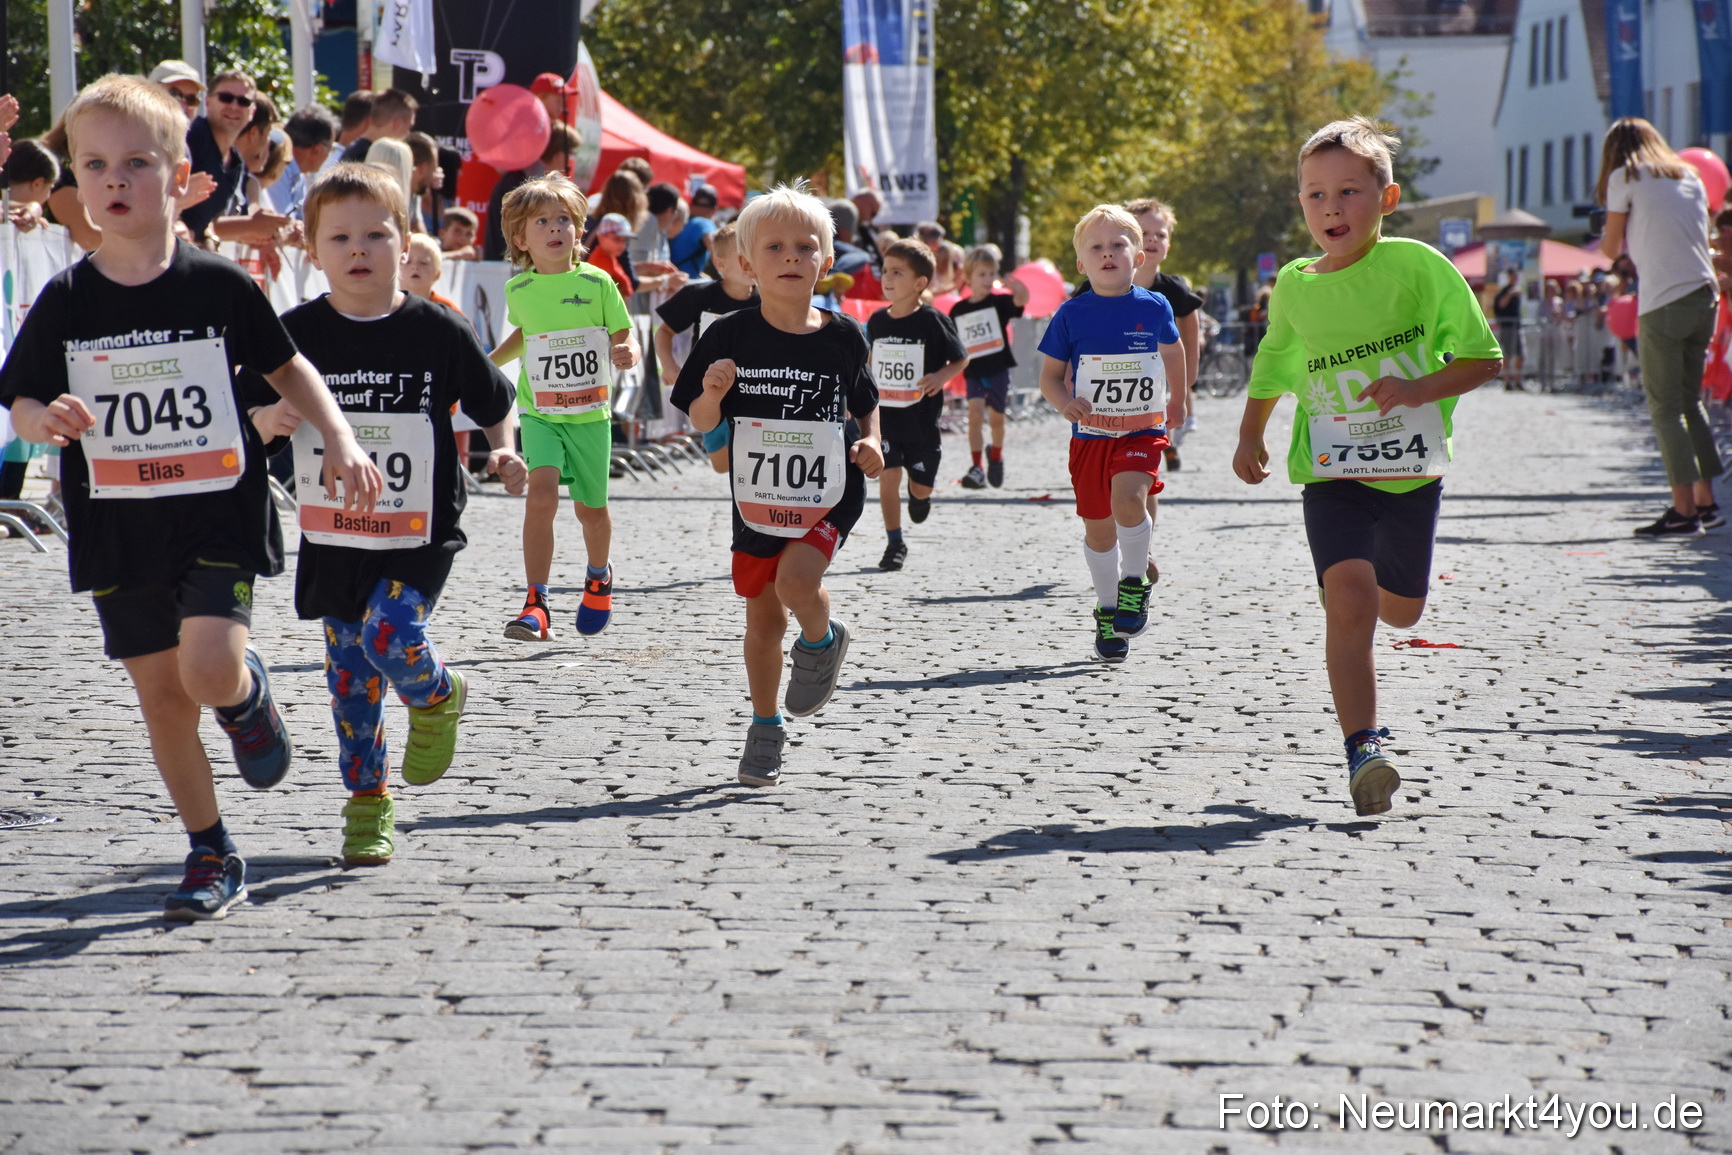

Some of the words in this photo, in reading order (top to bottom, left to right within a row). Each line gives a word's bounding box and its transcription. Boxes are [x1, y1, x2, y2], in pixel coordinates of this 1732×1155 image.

[66, 328, 172, 352] Neumarkter
[549, 335, 587, 348] BOCK
[1308, 354, 1327, 373] EAM
[1330, 324, 1425, 370] ALPENVEREIN
[111, 358, 182, 380] BOCK
[538, 350, 599, 380] 7508
[736, 366, 816, 382] Neumarkter
[878, 361, 915, 381] 7566
[1102, 361, 1142, 372] BOCK
[738, 382, 797, 400] Stadtlauf
[1090, 376, 1154, 404] 7578
[554, 393, 593, 408] Bjarne
[95, 385, 212, 437] 7043
[1348, 415, 1405, 436] BOCK
[112, 444, 142, 453] PARTL
[145, 438, 193, 451] Neumarkt
[762, 430, 814, 445] BOCK
[1332, 433, 1428, 462] 7554
[138, 462, 185, 482] Elias
[301, 476, 311, 484] B2
[747, 451, 828, 490] 7104
[1371, 466, 1411, 474] Neumarkt
[754, 491, 776, 501] PARTL
[776, 493, 811, 503] Neumarkt
[333, 512, 391, 534] Bastian
[768, 508, 803, 527] Vojta
